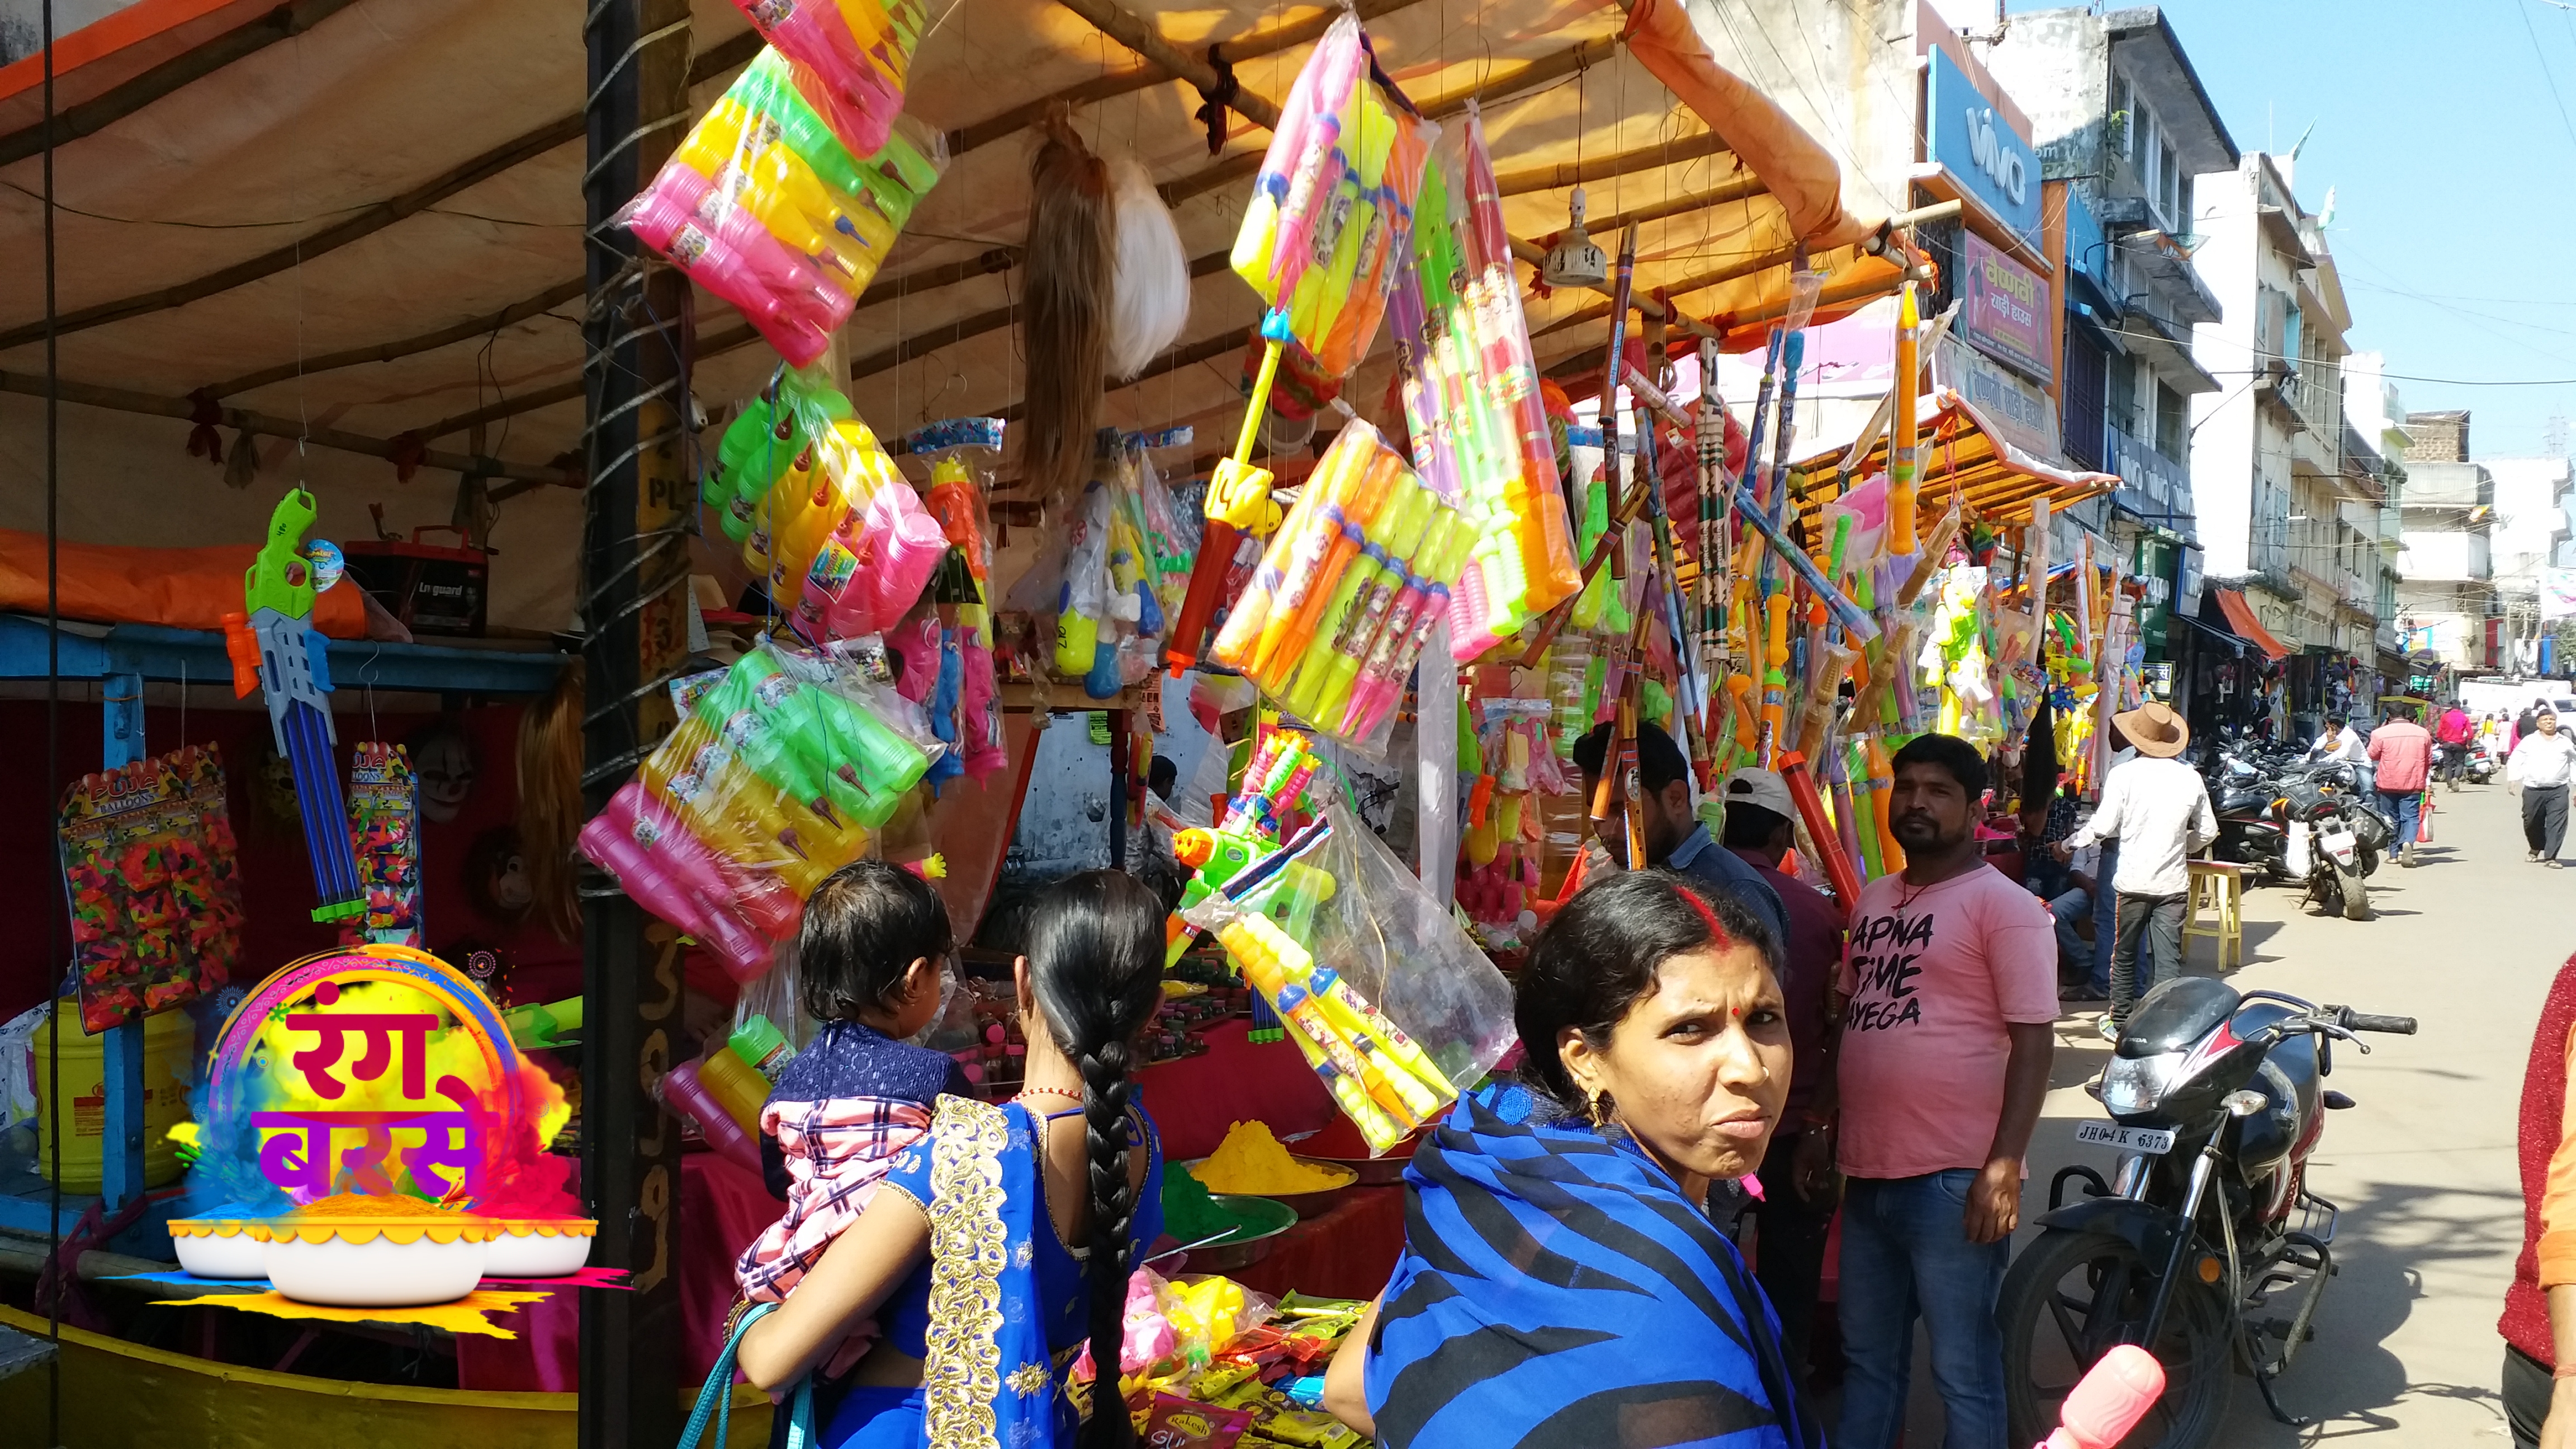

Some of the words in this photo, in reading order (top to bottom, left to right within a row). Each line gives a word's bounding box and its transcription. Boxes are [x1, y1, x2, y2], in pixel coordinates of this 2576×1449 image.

[1966, 107, 2026, 206] vivo
[2115, 445, 2143, 491] vivo
[2146, 464, 2169, 506] vivo
[352, 755, 387, 770] UJA
[89, 775, 159, 803] PUJA
[100, 794, 155, 813] BALLOONS
[1852, 913, 1934, 952] APNA
[2118, 1130, 2130, 1143] K
[1171, 1416, 1208, 1436] Rakesh
